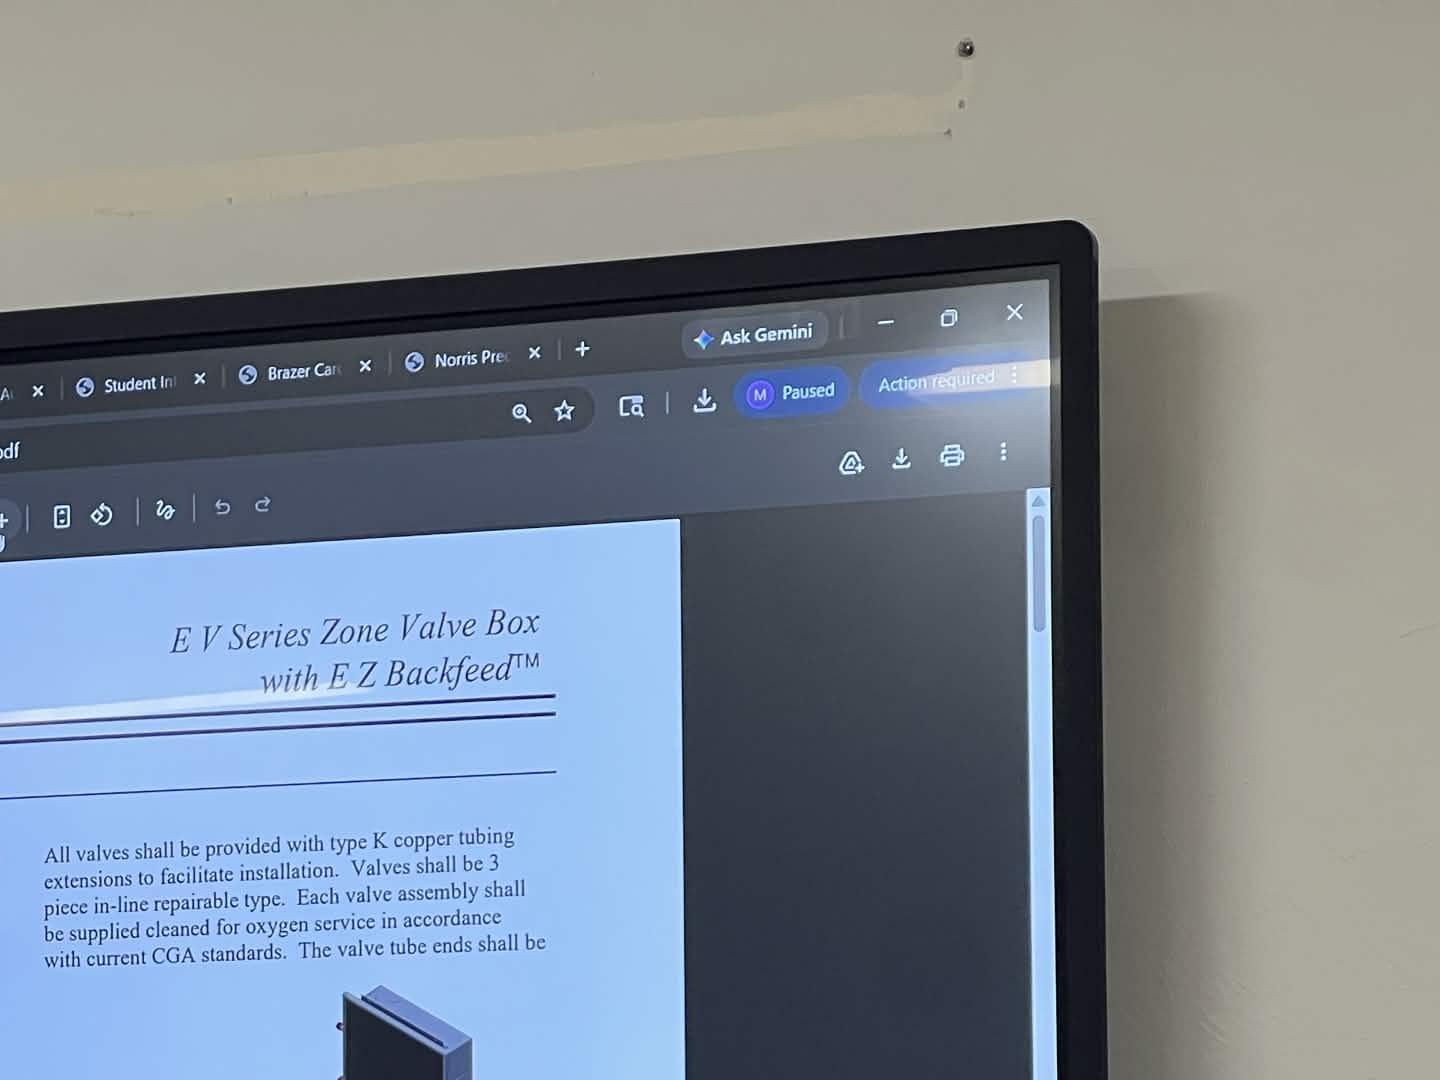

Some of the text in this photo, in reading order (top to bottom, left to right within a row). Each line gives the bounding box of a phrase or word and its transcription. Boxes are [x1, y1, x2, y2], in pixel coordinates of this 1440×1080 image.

[720, 323, 813, 346] Ask Gemini
[434, 351, 478, 367] Norris
[267, 364, 310, 380] Brazer
[878, 370, 996, 393] Action required
[104, 376, 156, 392] Student
[782, 382, 835, 400] Paused
[168, 609, 540, 654] E V Series Zone Valve Box
[260, 666, 318, 692] with
[327, 664, 350, 689] E
[356, 663, 377, 688] Z
[43, 827, 515, 864] All valves shall be provided with type K copper tubing
[43, 852, 499, 889] extensions to facilitate installation. Valves shall be 3
[43, 879, 525, 919] piece in-line repairable type. Each valve assembly shall
